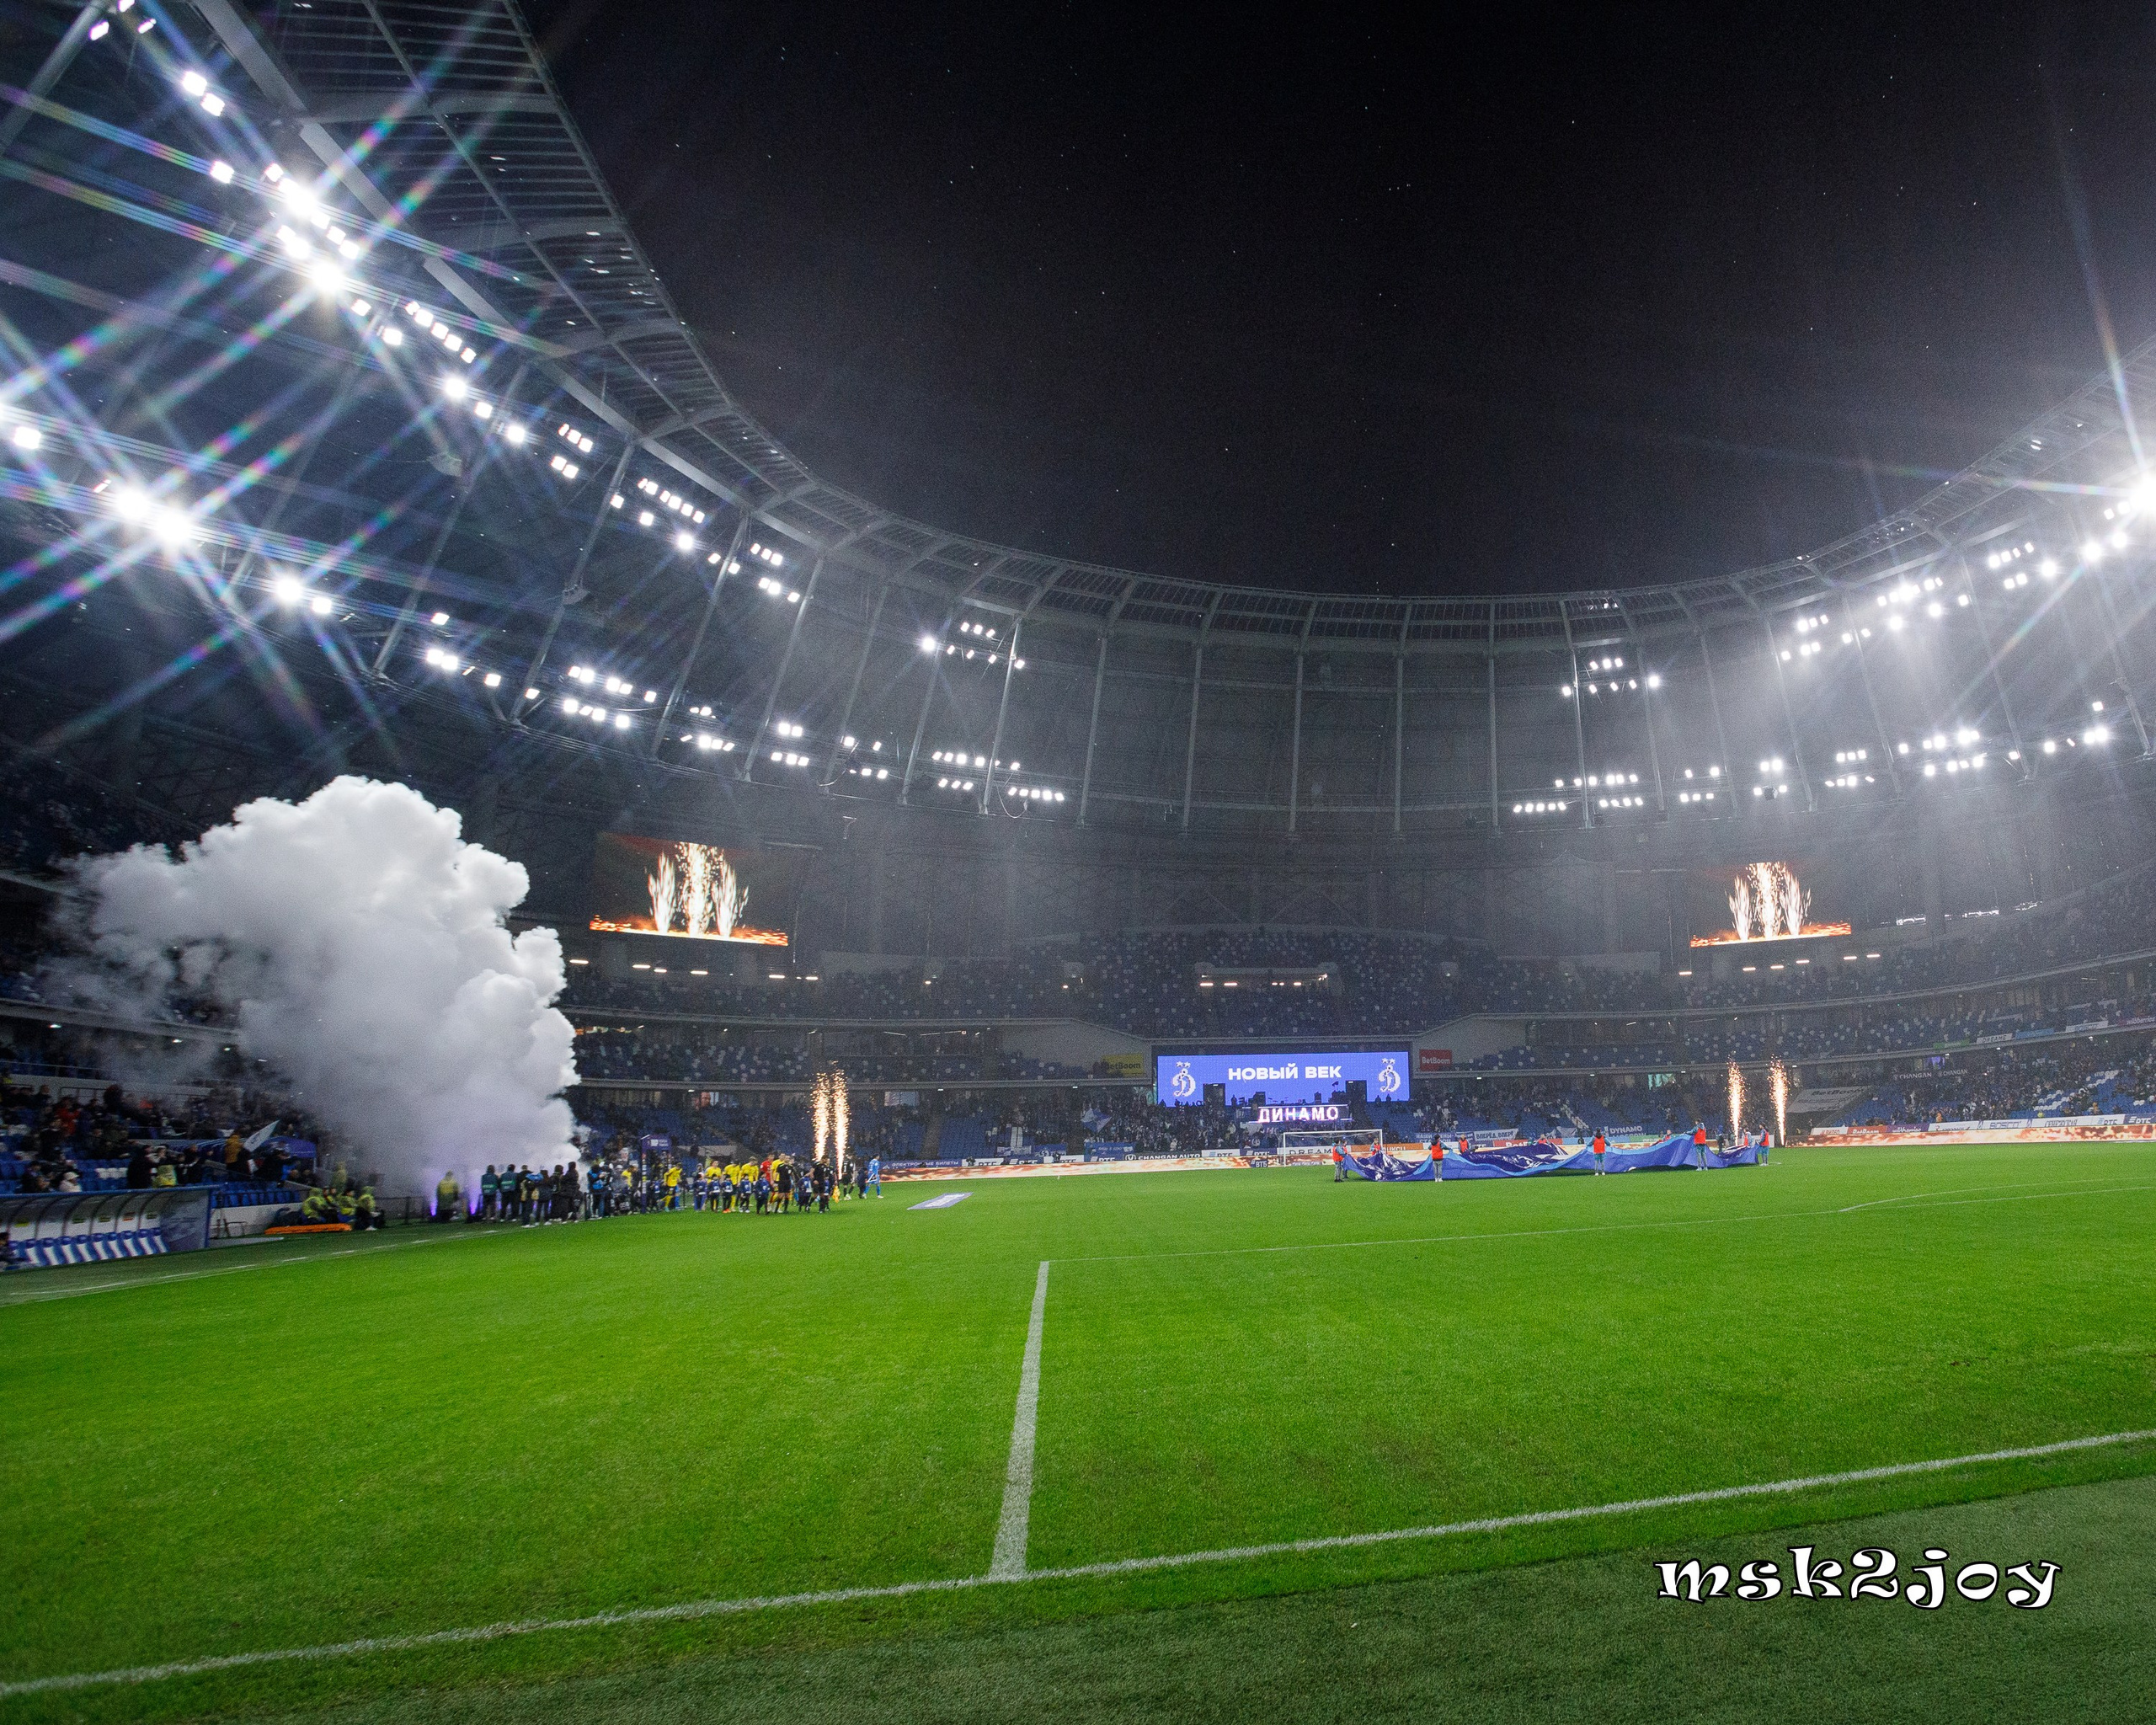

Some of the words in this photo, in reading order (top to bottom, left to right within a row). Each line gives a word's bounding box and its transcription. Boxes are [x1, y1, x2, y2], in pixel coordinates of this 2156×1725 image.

[1422, 1056, 1450, 1065] BetBoom
[1109, 1061, 1141, 1070] etBoom
[1228, 1063, 1298, 1081] НОВЫЙ
[1305, 1065, 1342, 1079] ВЕК
[1257, 1106, 1338, 1123] ДИНАМО
[1609, 1125, 1642, 1134] DYNAMO
